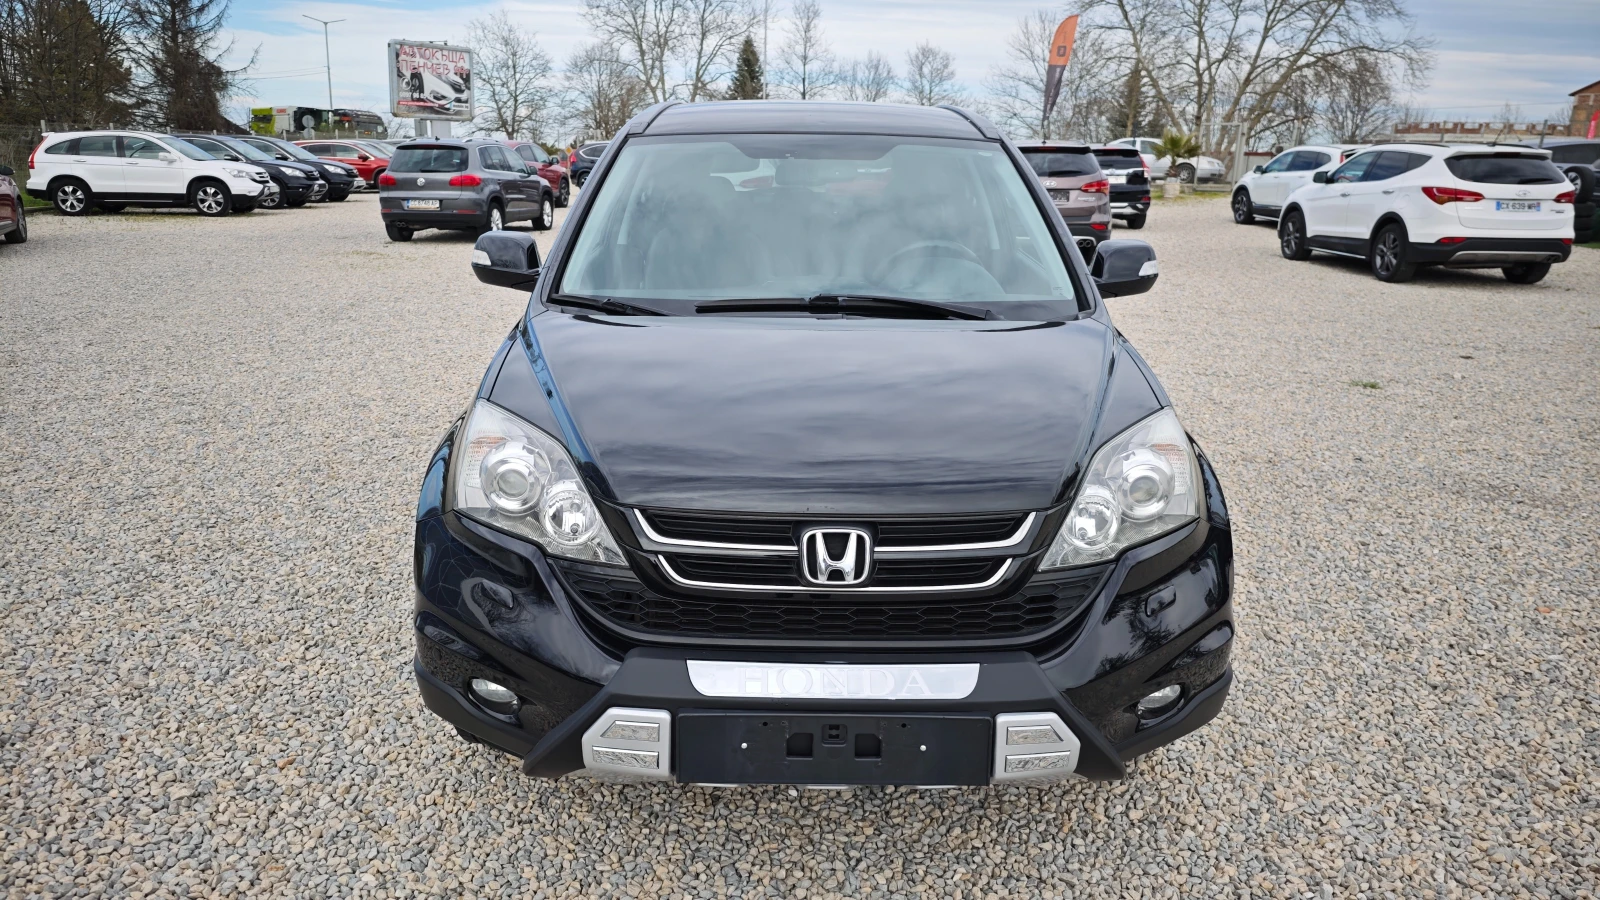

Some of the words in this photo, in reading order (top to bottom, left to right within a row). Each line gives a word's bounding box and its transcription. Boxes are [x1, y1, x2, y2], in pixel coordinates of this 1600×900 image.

[399, 44, 466, 65] АВТОКЪЩА
[400, 60, 450, 75] ПЕНЧЕВ
[737, 667, 935, 697] HONDA
